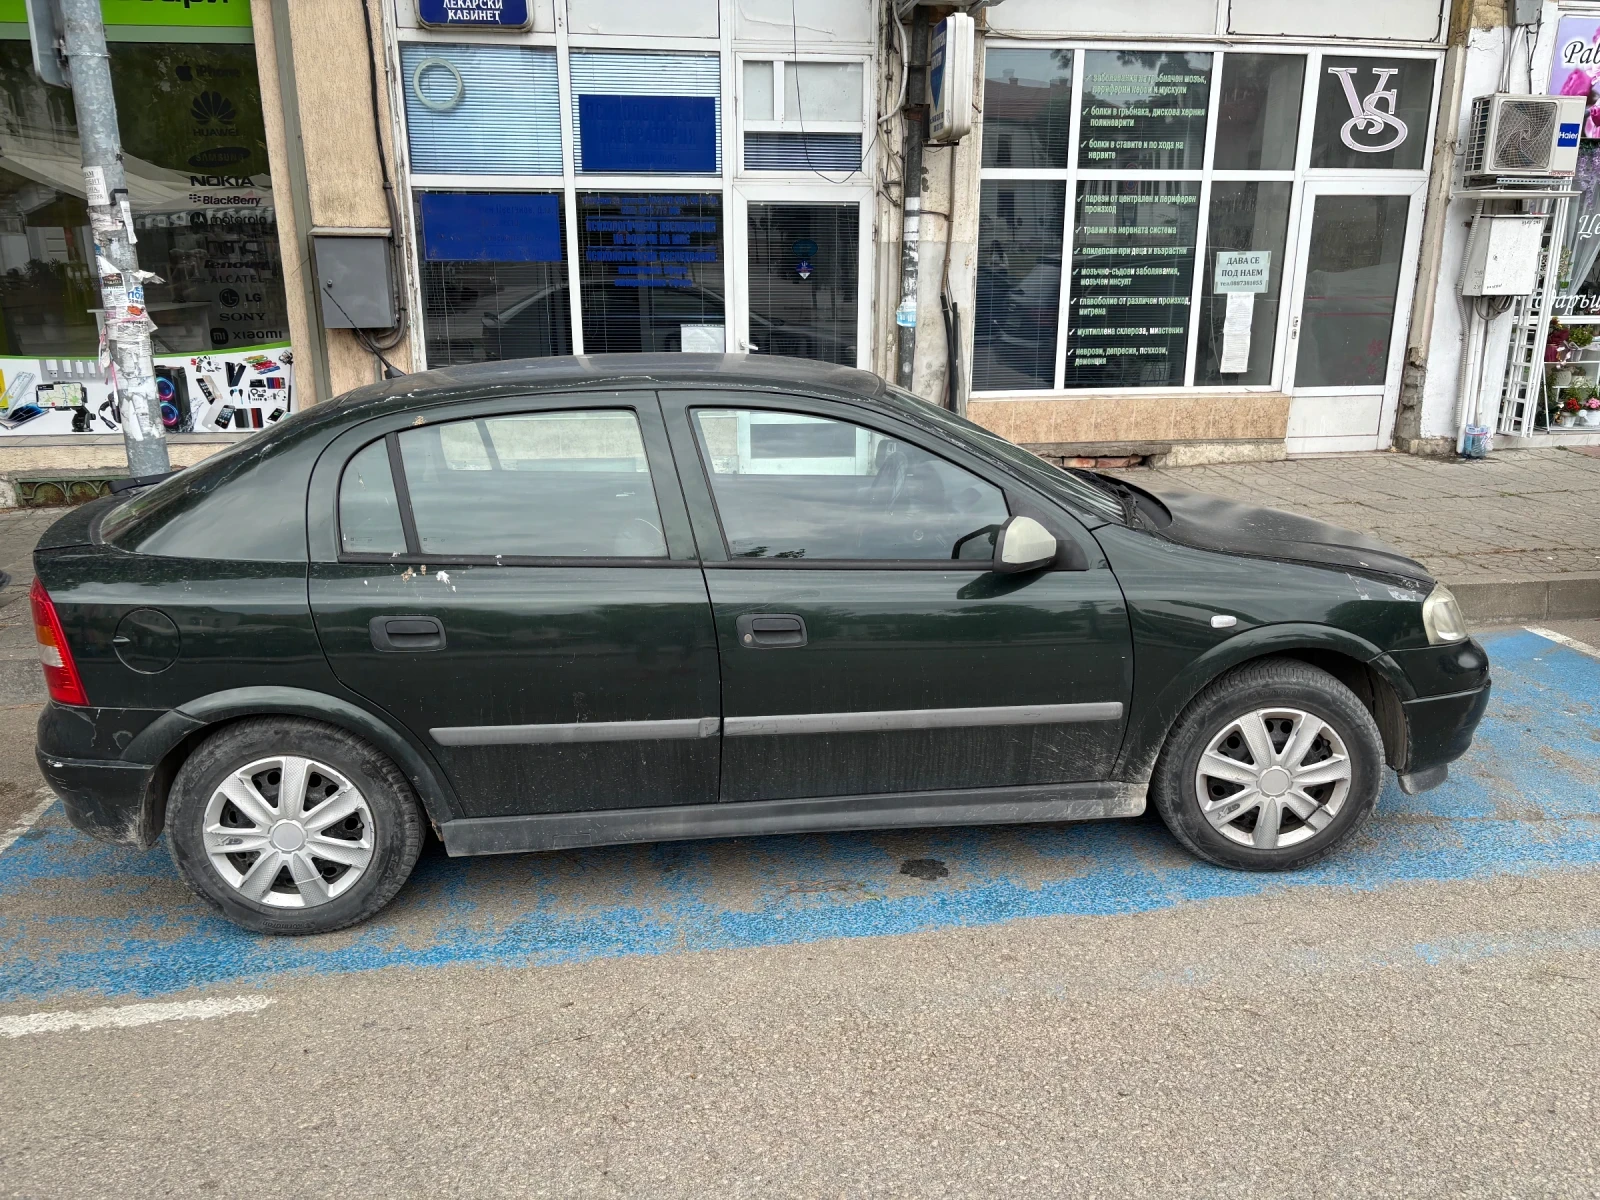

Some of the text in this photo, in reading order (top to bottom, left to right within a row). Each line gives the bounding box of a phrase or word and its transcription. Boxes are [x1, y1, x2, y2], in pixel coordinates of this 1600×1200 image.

[447, 10, 501, 21] КАБИНЕТ
[1091, 106, 1112, 116] болки
[1151, 108, 1180, 117] дискова
[192, 128, 240, 137] HUAWEI
[1559, 131, 1579, 140] Haier
[1088, 139, 1110, 149] болки
[1158, 141, 1174, 150] хода
[196, 152, 244, 162] SAMSUNG
[1088, 151, 1116, 160] нервите
[190, 175, 255, 186] NOKIA
[202, 195, 261, 207] BlackBerry
[1085, 195, 1110, 203] парези
[1119, 195, 1154, 204] централен
[1159, 194, 1197, 204] периферен
[1084, 206, 1117, 214] произход
[210, 214, 267, 226] motorola
[1083, 227, 1108, 235] травми
[1117, 227, 1149, 235] нервната
[1149, 226, 1177, 234] система
[1118, 248, 1131, 256] при
[1131, 247, 1147, 256] деца
[1153, 247, 1188, 256] възрастни
[1226, 256, 1260, 266] ДАВА СЕ
[1080, 266, 1180, 277] мозъчно-съдови заболявания,
[1221, 269, 1263, 278] ПОД НАЕМ
[210, 274, 265, 283] ALCATEL
[1080, 278, 1132, 287] мозъчен инсулт
[245, 293, 262, 302] LG
[1079, 297, 1191, 306] главоболие от различен произход,
[220, 312, 266, 320] SONY
[1079, 308, 1106, 316] мигрена
[1077, 327, 1184, 337] мултиплена склероза, миастения
[1075, 348, 1105, 356] неврози,
[1105, 347, 1139, 356] депресия,
[1074, 358, 1107, 366] деменция
